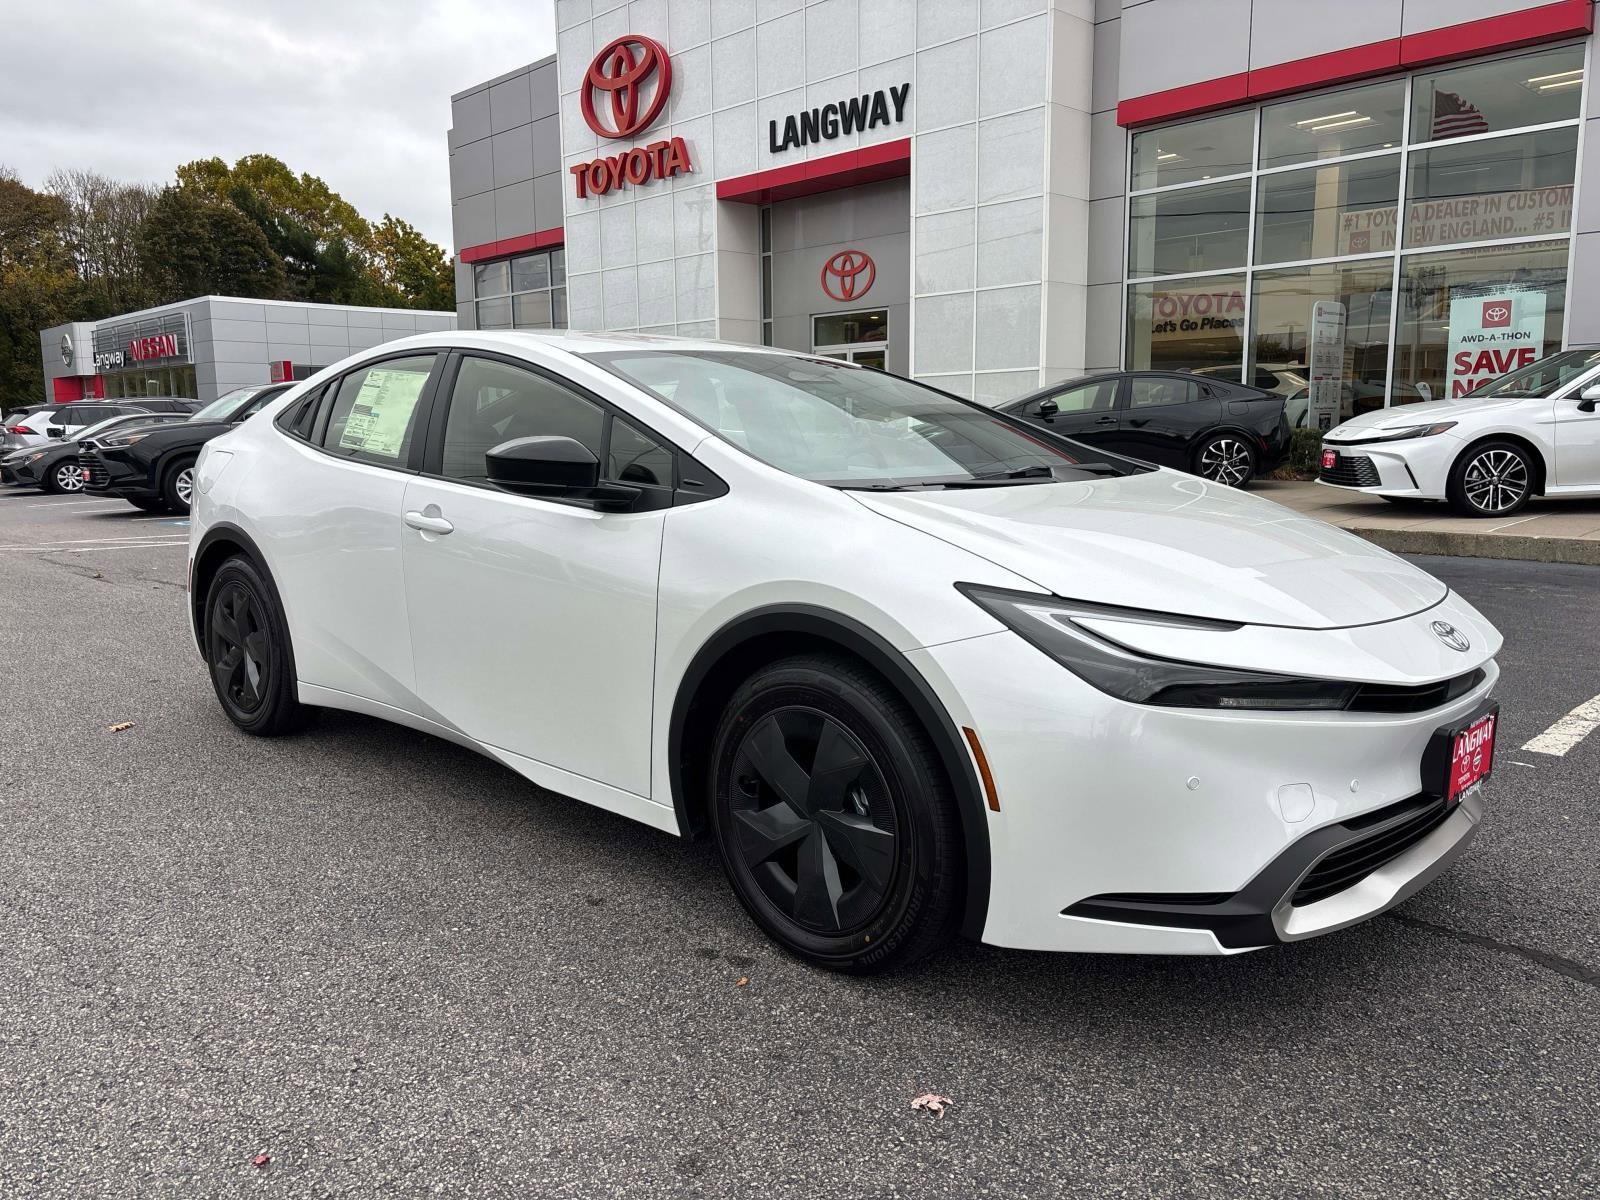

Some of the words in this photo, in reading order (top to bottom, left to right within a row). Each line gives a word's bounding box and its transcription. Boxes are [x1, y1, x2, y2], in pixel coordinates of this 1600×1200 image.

[769, 82, 910, 153] LANGWAY
[570, 136, 692, 199] TOYOTA
[1343, 214, 1361, 232] #1
[1366, 206, 1420, 228] TOYOA
[1425, 199, 1479, 222] DEALER
[1484, 197, 1501, 215] IN
[1381, 230, 1397, 247] IN
[1440, 216, 1527, 240] ENGLAND...
[1533, 212, 1555, 231] #5
[1180, 319, 1198, 331] Go
[1460, 331, 1531, 343] AWD-A-THON
[93, 351, 126, 369] Langway
[130, 333, 179, 361] NISSAN
[1453, 347, 1536, 376] SAVE
[1453, 719, 1494, 762] LANGWAY
